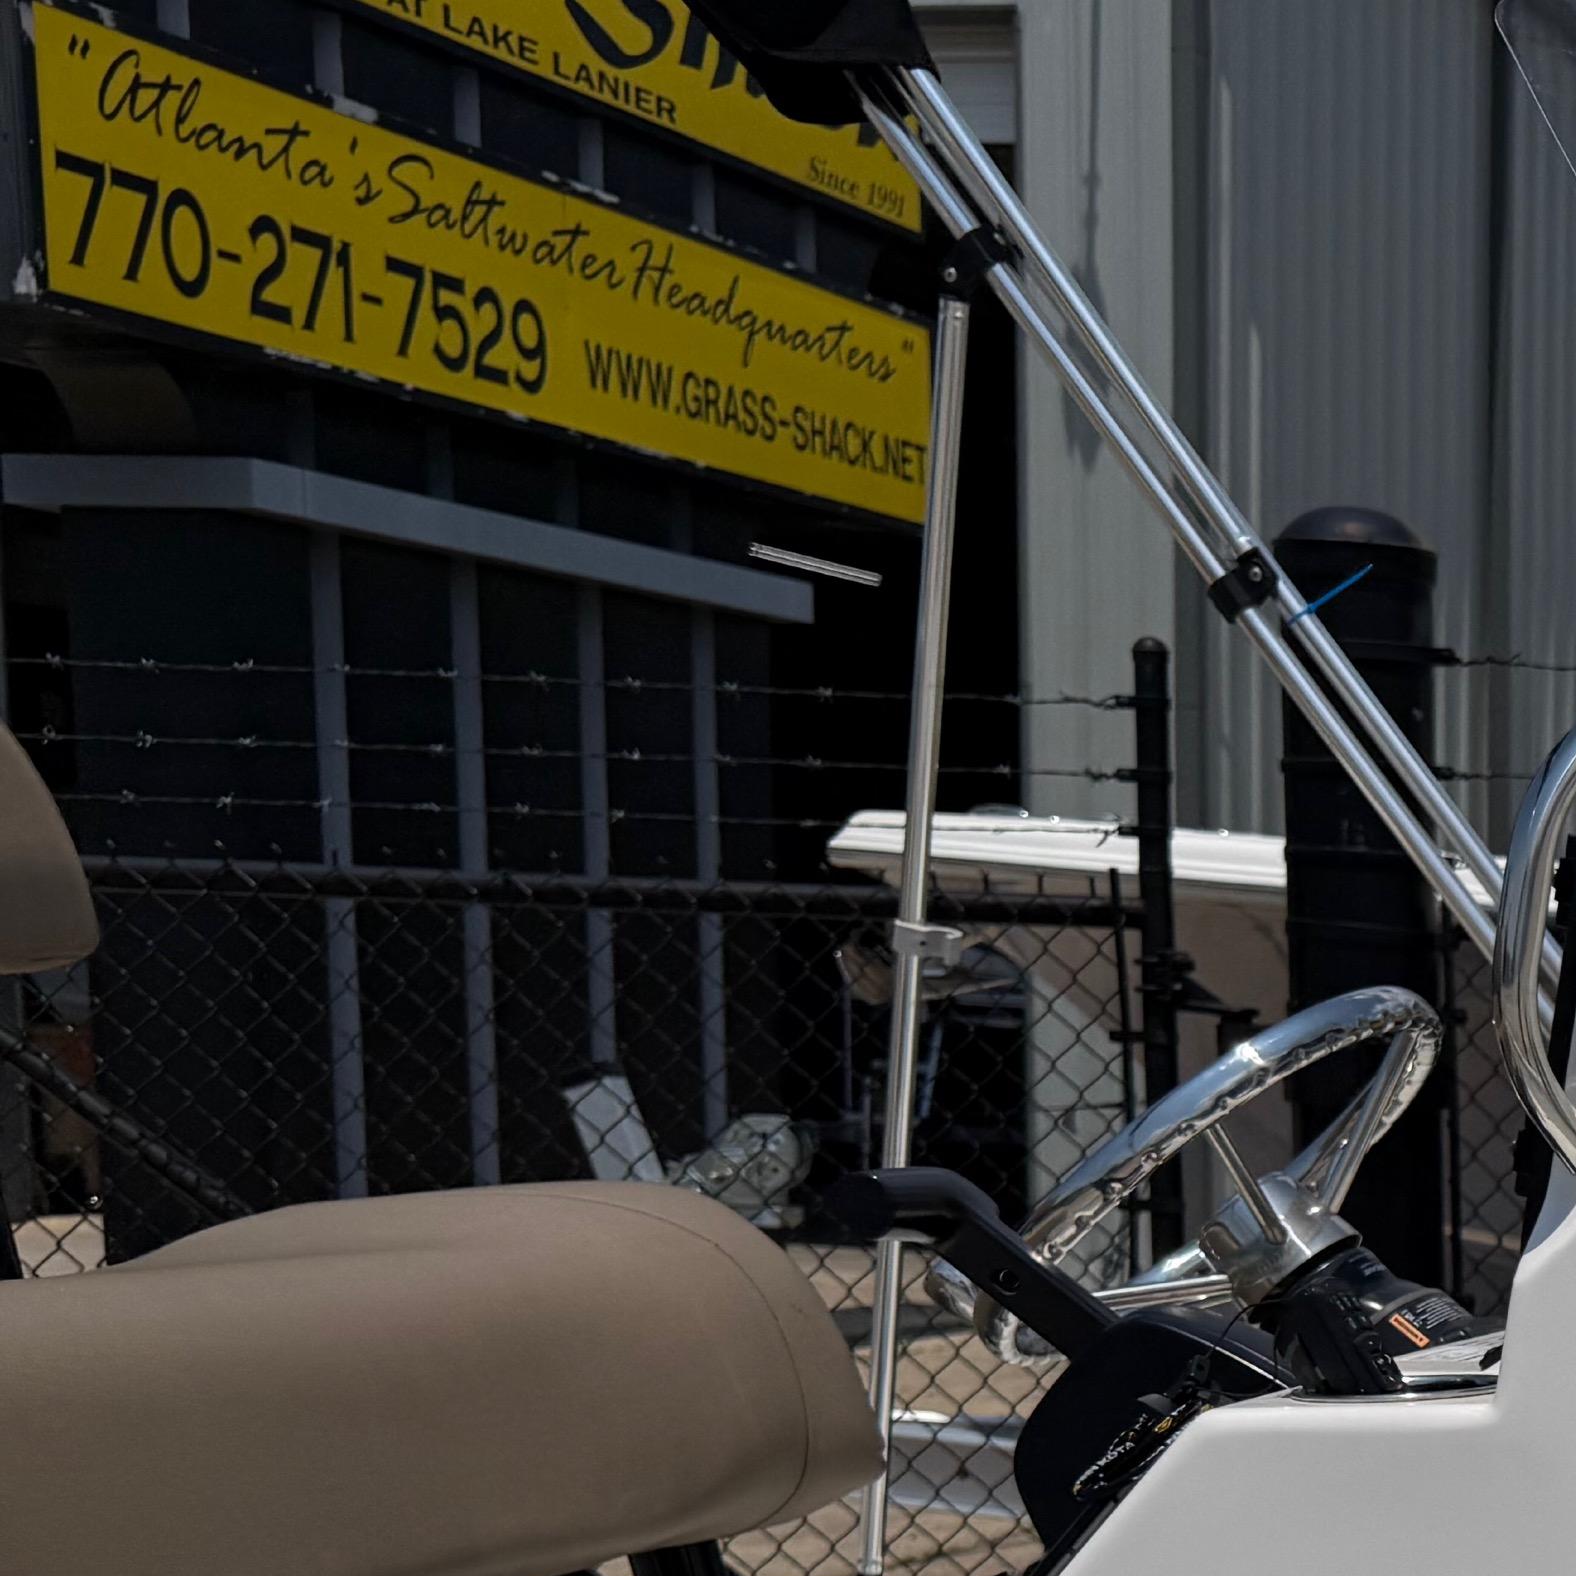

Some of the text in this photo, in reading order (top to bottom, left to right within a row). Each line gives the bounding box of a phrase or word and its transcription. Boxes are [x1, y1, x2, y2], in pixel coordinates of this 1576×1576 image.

[442, 2, 539, 65] LAKE
[552, 51, 677, 124] LANIER
[387, 153, 626, 290] Saltwater
[808, 155, 906, 218] Since 1991
[54, 147, 549, 396] 770-271-7529
[583, 338, 928, 486] WWW.GRASS-SHACK.NET
